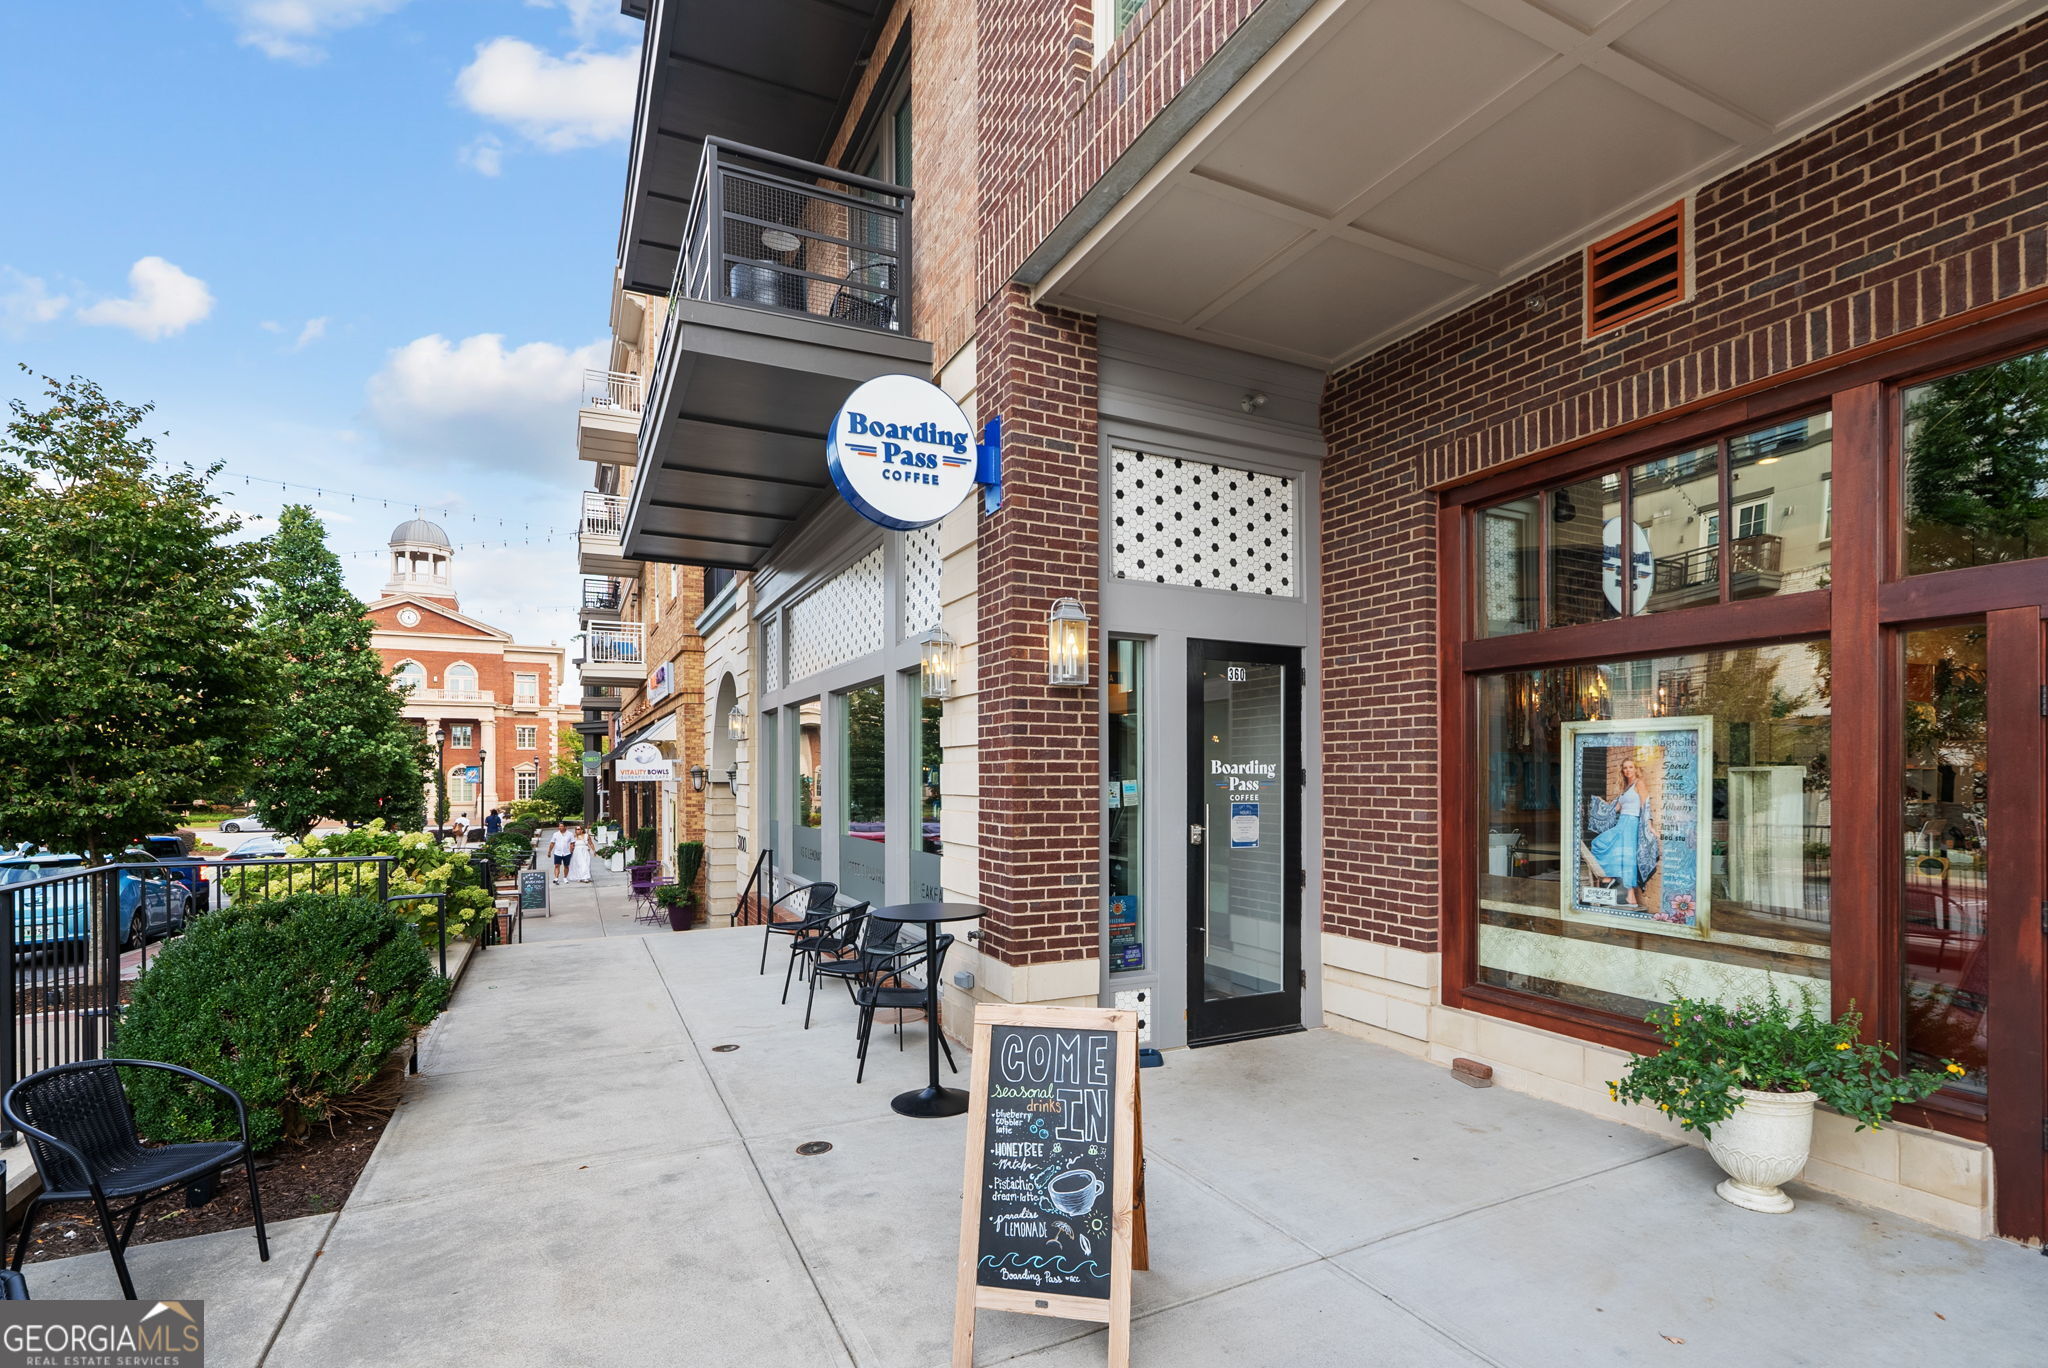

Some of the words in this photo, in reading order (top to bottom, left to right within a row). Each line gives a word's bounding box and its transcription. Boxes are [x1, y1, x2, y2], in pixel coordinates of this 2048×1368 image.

[847, 411, 968, 454] Boarding
[882, 441, 938, 469] Pass
[882, 468, 940, 486] COFFEE
[1228, 668, 1245, 681] 360
[1211, 759, 1276, 779] Boarding
[1661, 761, 1690, 770] Spirit
[1229, 776, 1259, 791] Pass
[1661, 772, 1683, 781] Lala
[1229, 794, 1259, 802] COFFEE
[1661, 793, 1697, 801] PEOPLE
[1001, 1033, 1108, 1085] COME
[991, 1083, 1055, 1099] seasonal
[1026, 1099, 1062, 1113] drinks
[995, 1109, 1033, 1122] blueberry
[995, 1117, 1023, 1126] cobbler
[1055, 1088, 1108, 1144] IN
[995, 1125, 1013, 1134] latte
[995, 1142, 1044, 1157] HONEYBEE
[994, 1176, 1034, 1190] Pistachio
[994, 1207, 1039, 1232] paradise
[1004, 1221, 1048, 1238] LEMONADE
[1000, 1267, 1042, 1286] Boarding
[1045, 1271, 1063, 1283] Pass
